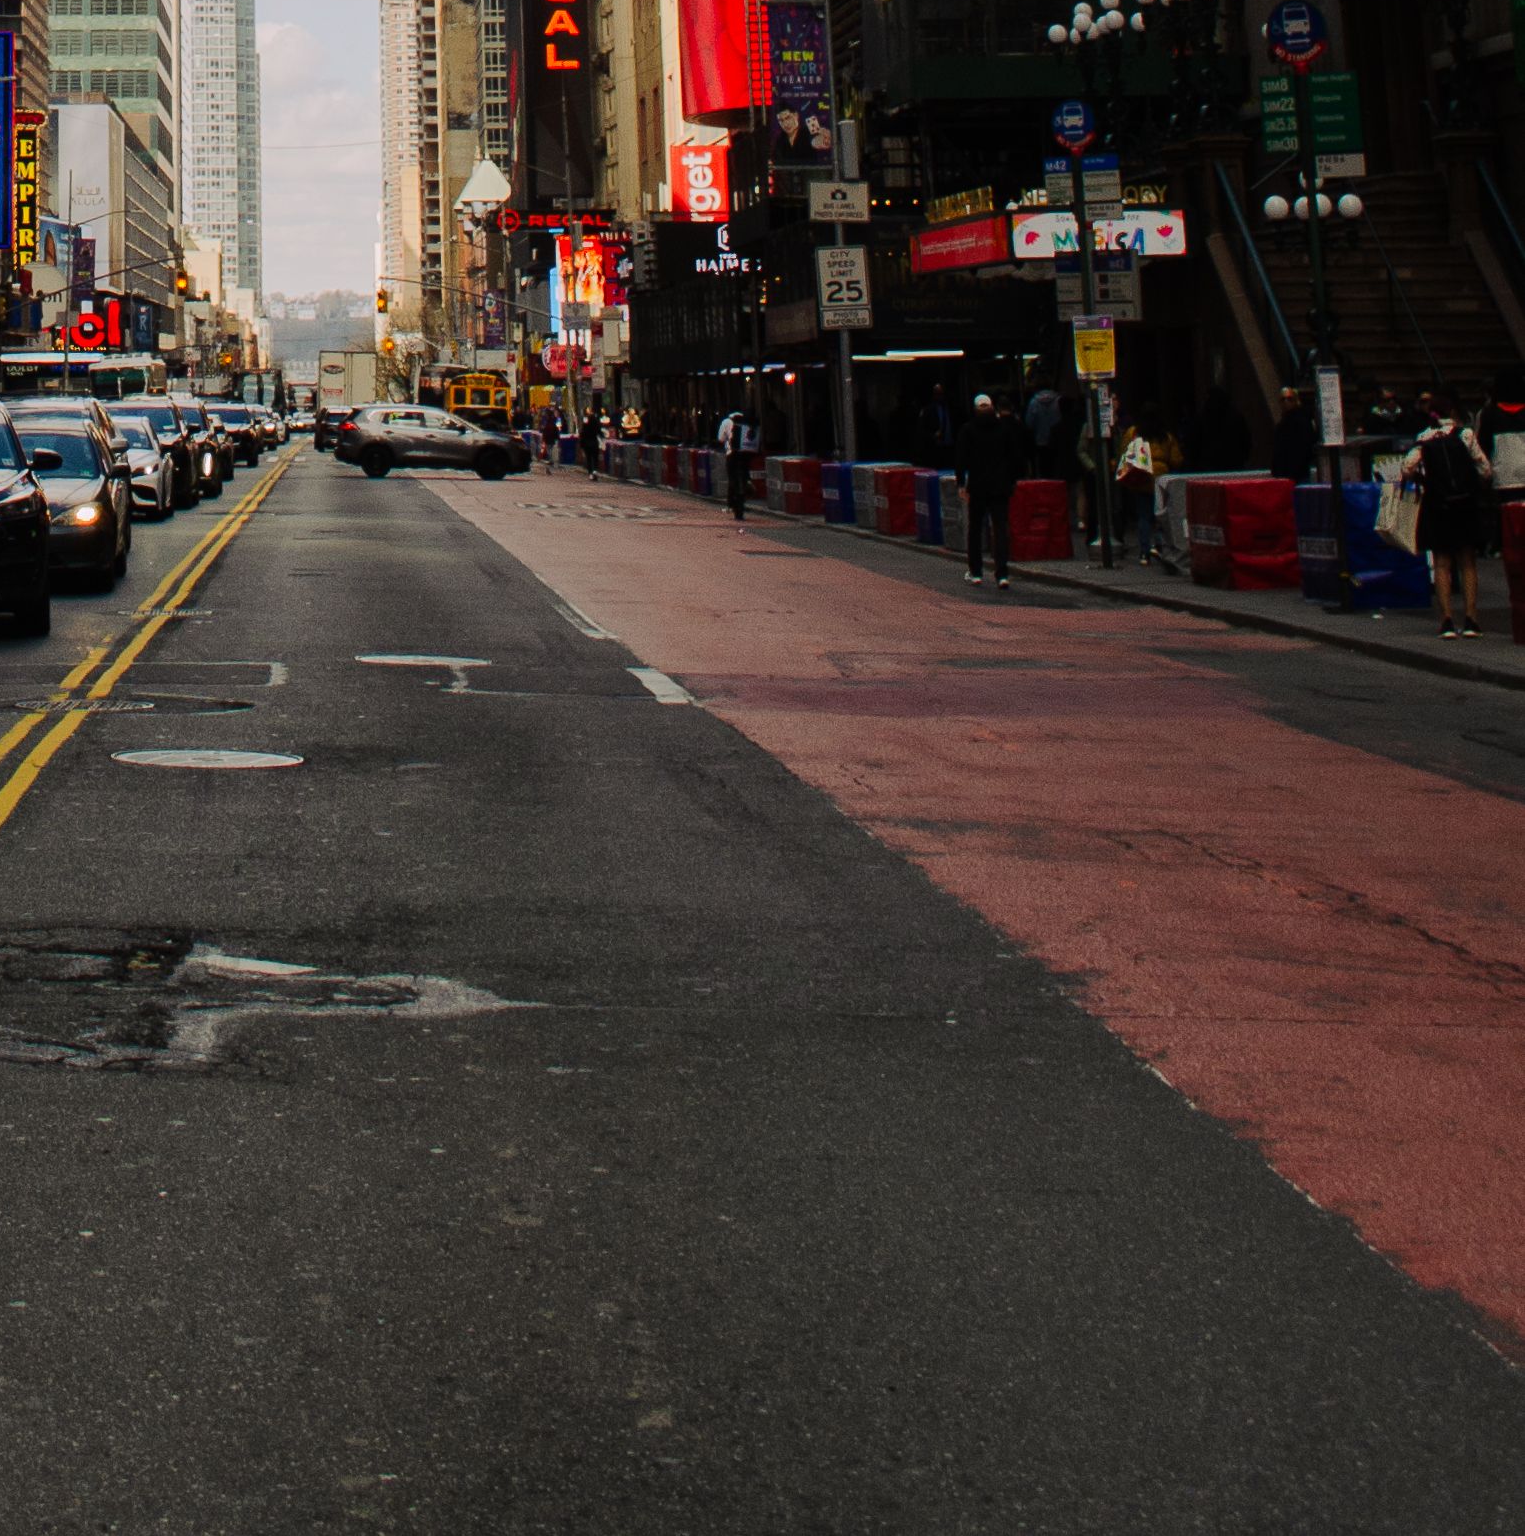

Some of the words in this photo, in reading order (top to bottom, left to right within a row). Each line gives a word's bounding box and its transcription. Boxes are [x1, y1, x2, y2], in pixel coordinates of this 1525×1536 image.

[781, 50, 815, 62] NEW
[17, 138, 35, 267] EMPIRE
[830, 250, 851, 259] CITY
[826, 260, 856, 268] SPEED
[830, 270, 853, 278] LIMIT
[826, 280, 863, 303] 25
